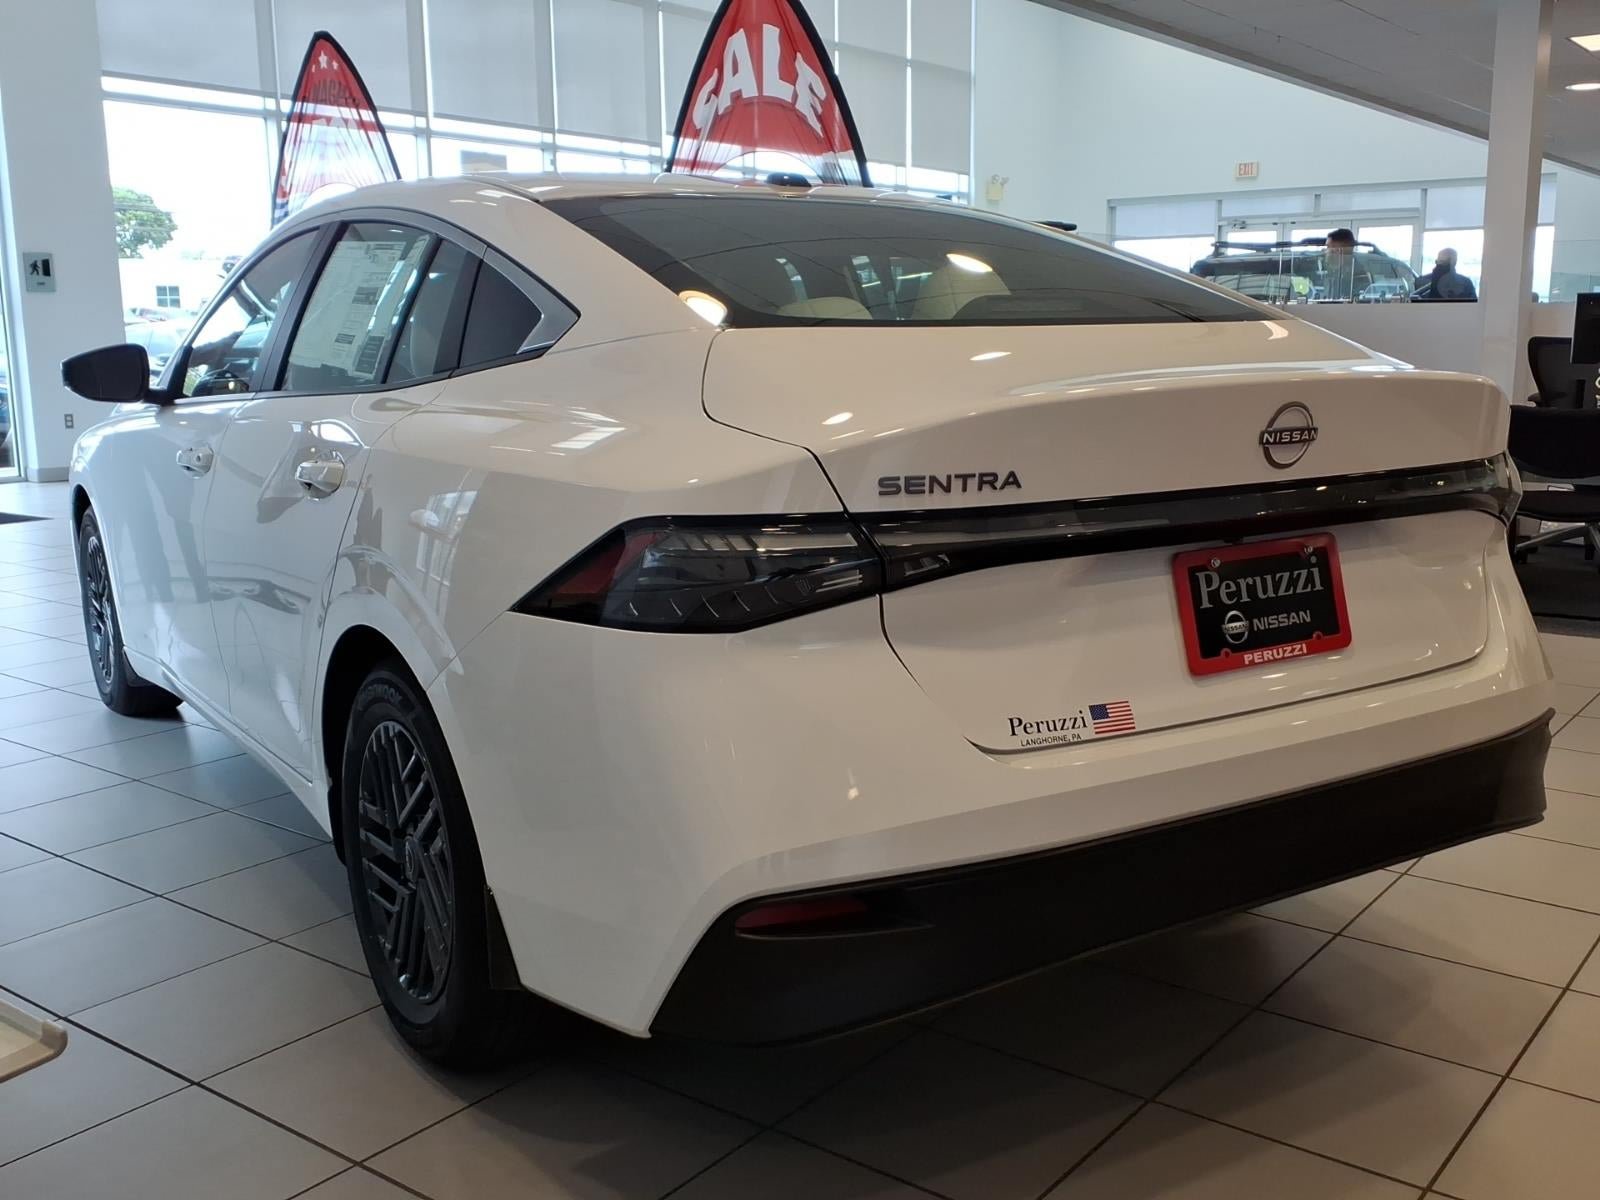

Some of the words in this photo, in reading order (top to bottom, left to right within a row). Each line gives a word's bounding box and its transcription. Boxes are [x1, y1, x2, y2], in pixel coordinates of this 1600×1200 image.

[1262, 426, 1319, 445] NISSAN
[877, 470, 1022, 496] SENTRA
[1195, 556, 1325, 609] Peruzzi
[1253, 609, 1312, 631] NISSAN
[1243, 643, 1308, 665] PERUZZI
[1008, 710, 1088, 736] Peruzzi
[1020, 734, 1071, 747] LANGHORNE,
[1072, 733, 1082, 742] PA
